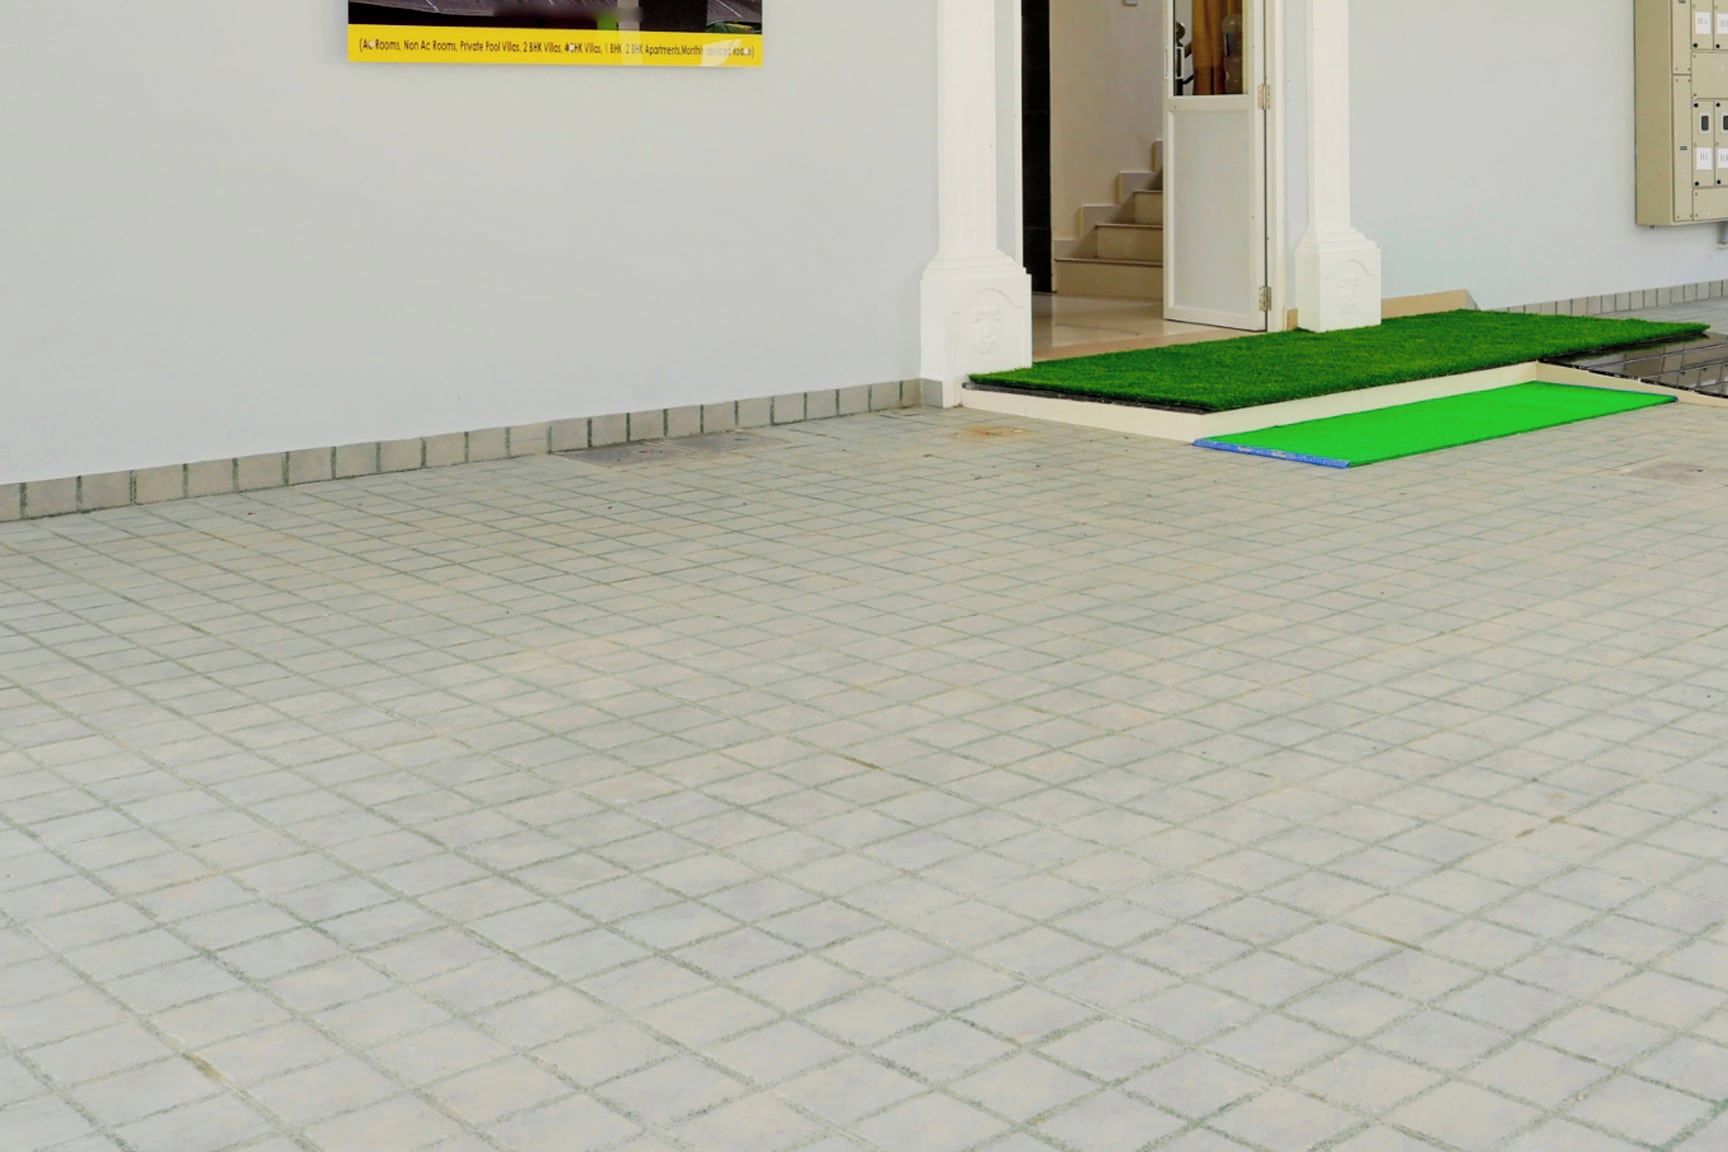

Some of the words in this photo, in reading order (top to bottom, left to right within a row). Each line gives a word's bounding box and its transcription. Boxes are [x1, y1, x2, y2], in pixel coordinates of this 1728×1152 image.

[404, 40, 419, 50] Non
[421, 40, 430, 51] Ac
[432, 40, 458, 52] Rooms,
[460, 40, 484, 52] Private
[529, 42, 541, 53] BHK
